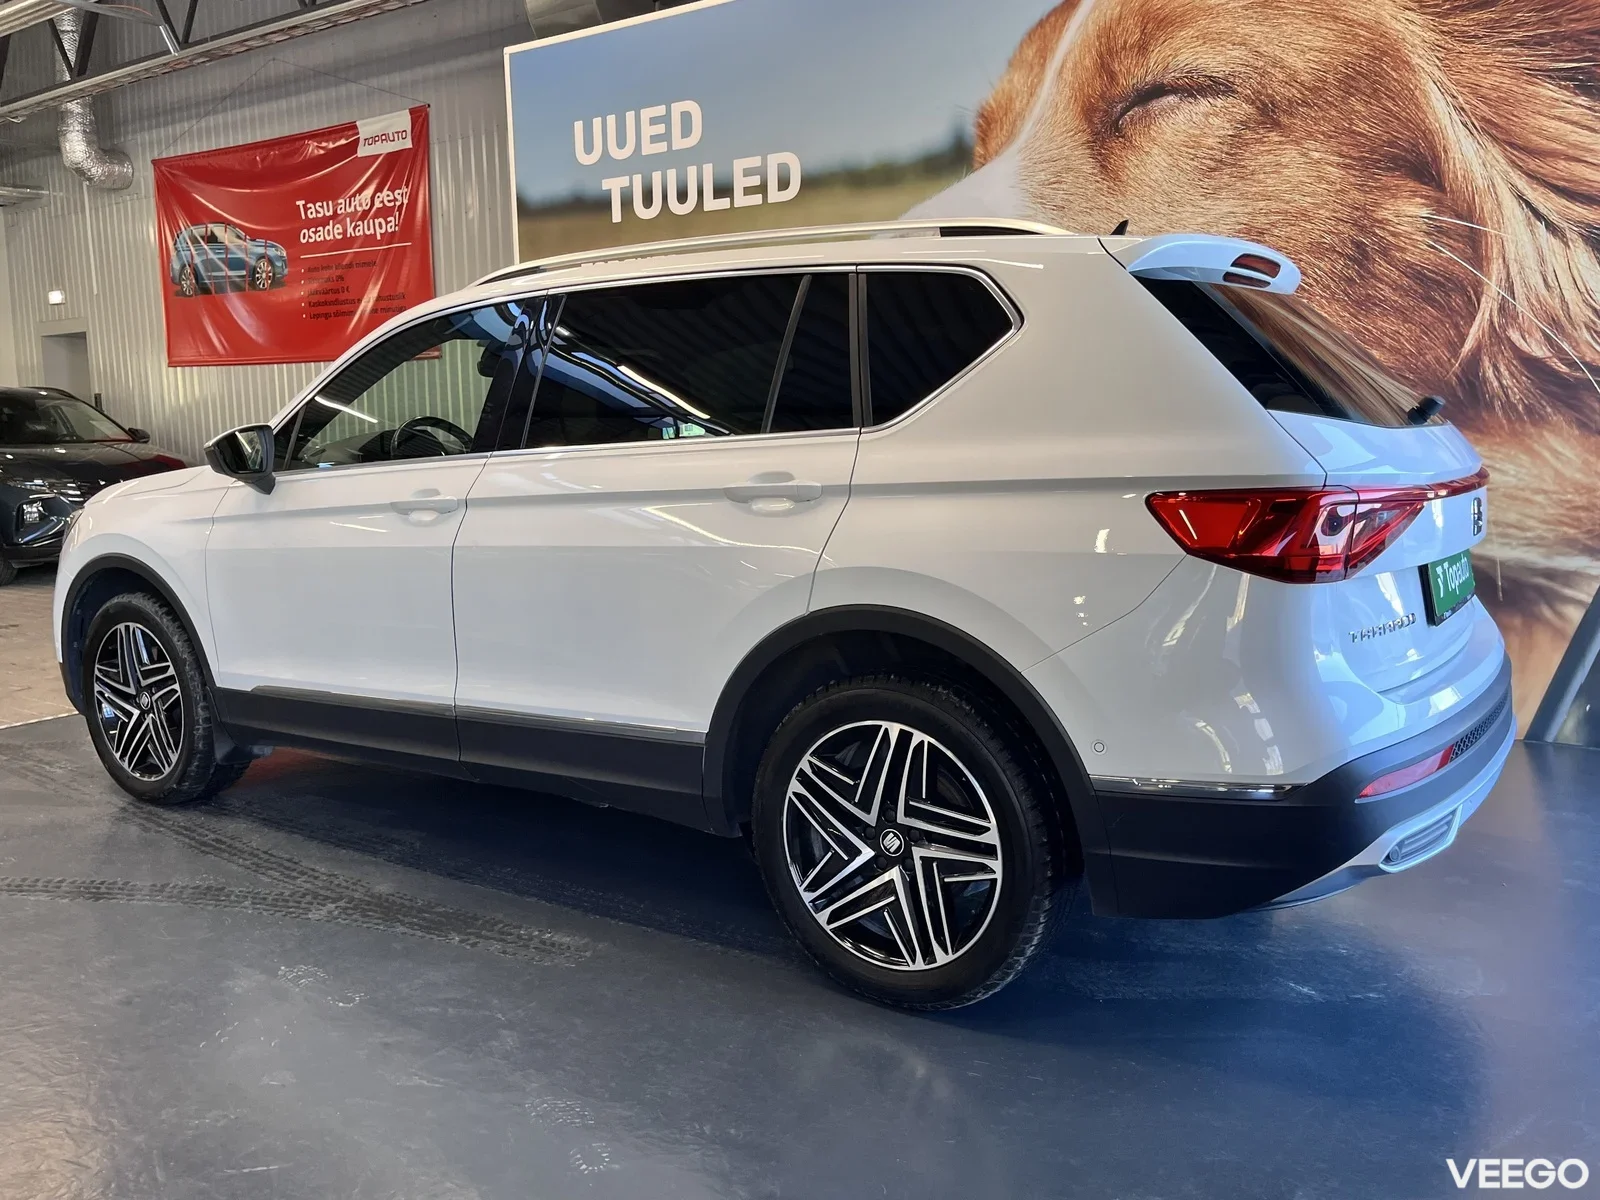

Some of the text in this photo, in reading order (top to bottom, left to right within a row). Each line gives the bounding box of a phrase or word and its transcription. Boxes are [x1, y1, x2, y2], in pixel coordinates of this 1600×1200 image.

[363, 130, 408, 147] TOPAUTO
[574, 100, 702, 165] UUED
[296, 186, 409, 220] Tasu auto eest
[601, 151, 801, 223] TUULED
[300, 211, 399, 244] osade kaupa!
[1443, 553, 1469, 595] Topauto
